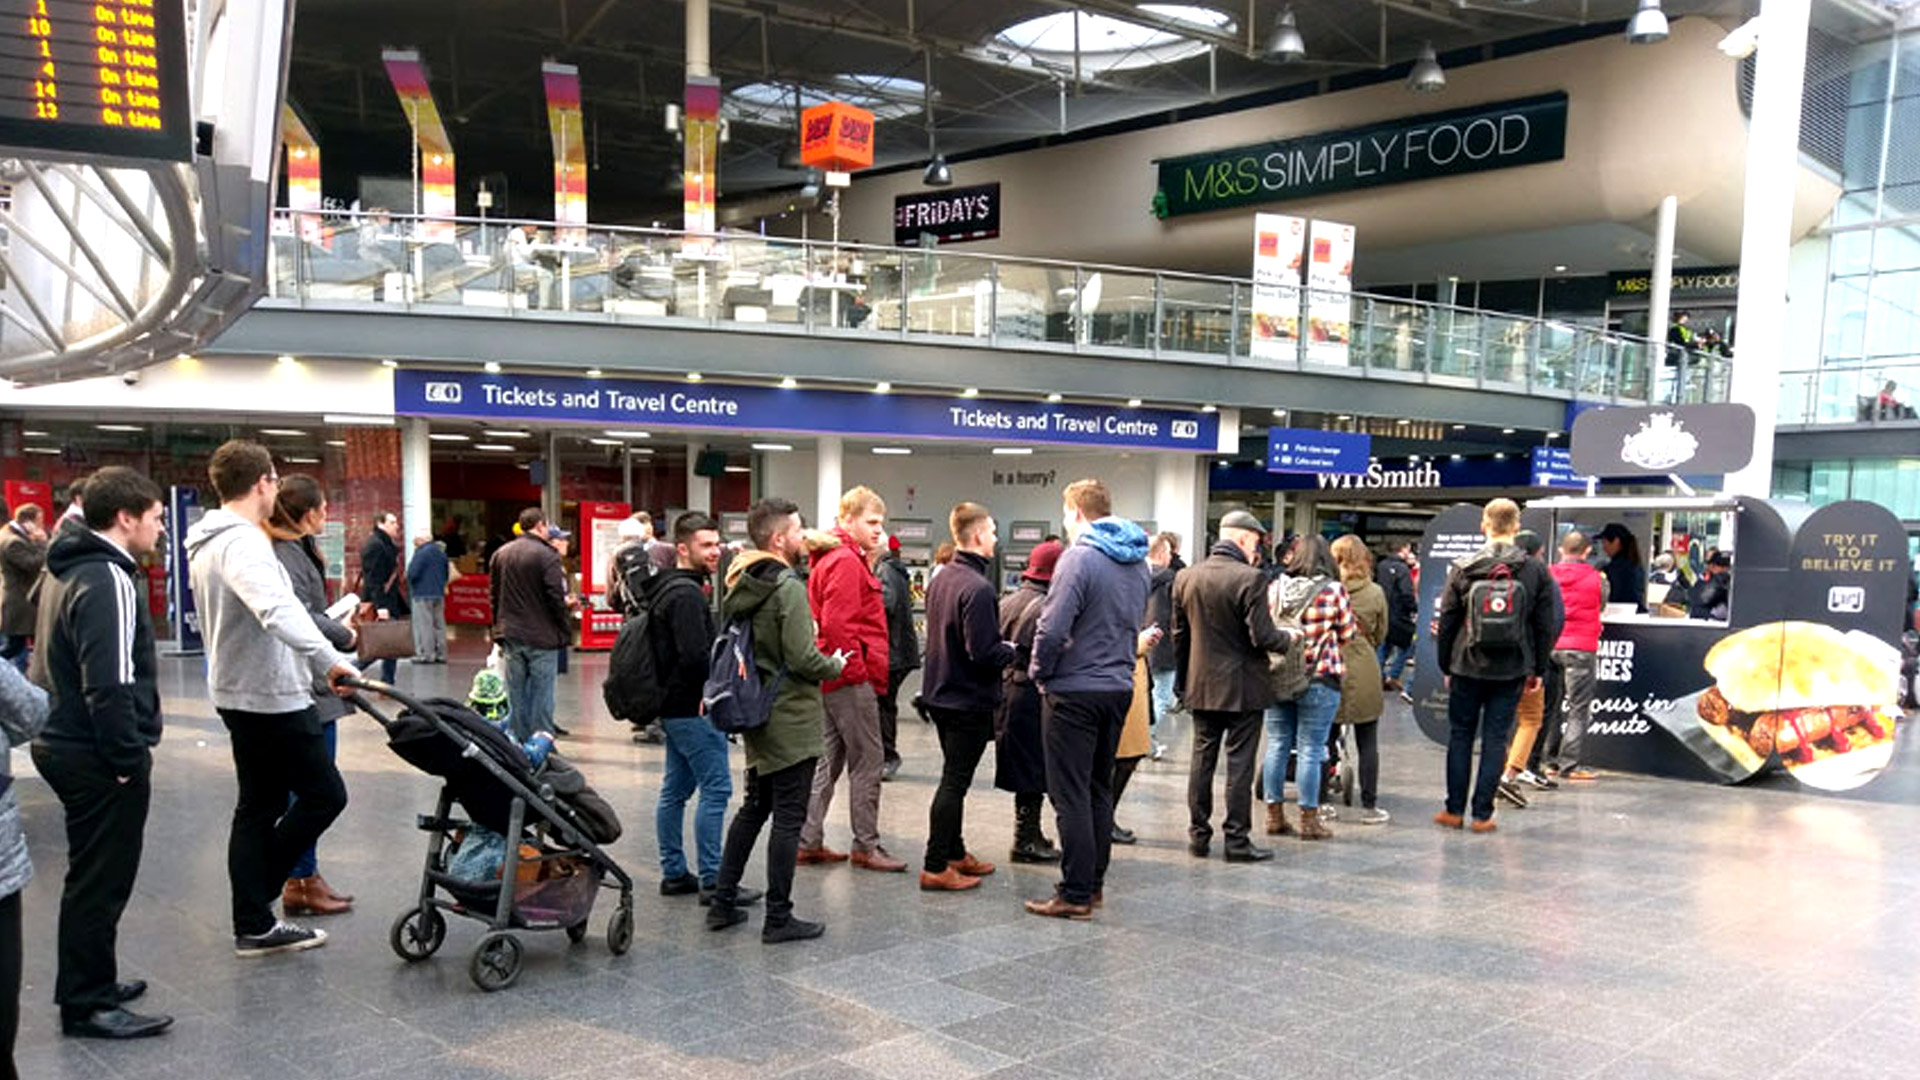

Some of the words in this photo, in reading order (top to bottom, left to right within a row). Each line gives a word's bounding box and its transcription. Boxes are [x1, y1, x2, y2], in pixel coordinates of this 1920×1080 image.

[29, 17, 51, 36] 10
[41, 40, 51, 57] 1
[42, 62, 55, 78] 4
[35, 81, 56, 98] 14
[37, 101, 58, 118] 13
[1184, 157, 1258, 202] M&S
[1261, 133, 1398, 192] SIMPLY
[1404, 113, 1531, 170] FOOD
[482, 384, 557, 407] Tickets
[563, 389, 600, 409] and
[607, 391, 665, 412] Travel
[671, 393, 738, 415] Centre
[950, 407, 1012, 429] Tickets
[1017, 413, 1048, 430] and
[1053, 413, 1100, 434] Travel
[1105, 416, 1159, 436] Centre
[1822, 533, 1856, 546] TRY
[1861, 533, 1879, 546] IT
[1837, 547, 1861, 558] TO
[1801, 558, 1874, 571] BELIEVE
[1878, 558, 1896, 571] IT
[1596, 658, 1633, 682] GES
